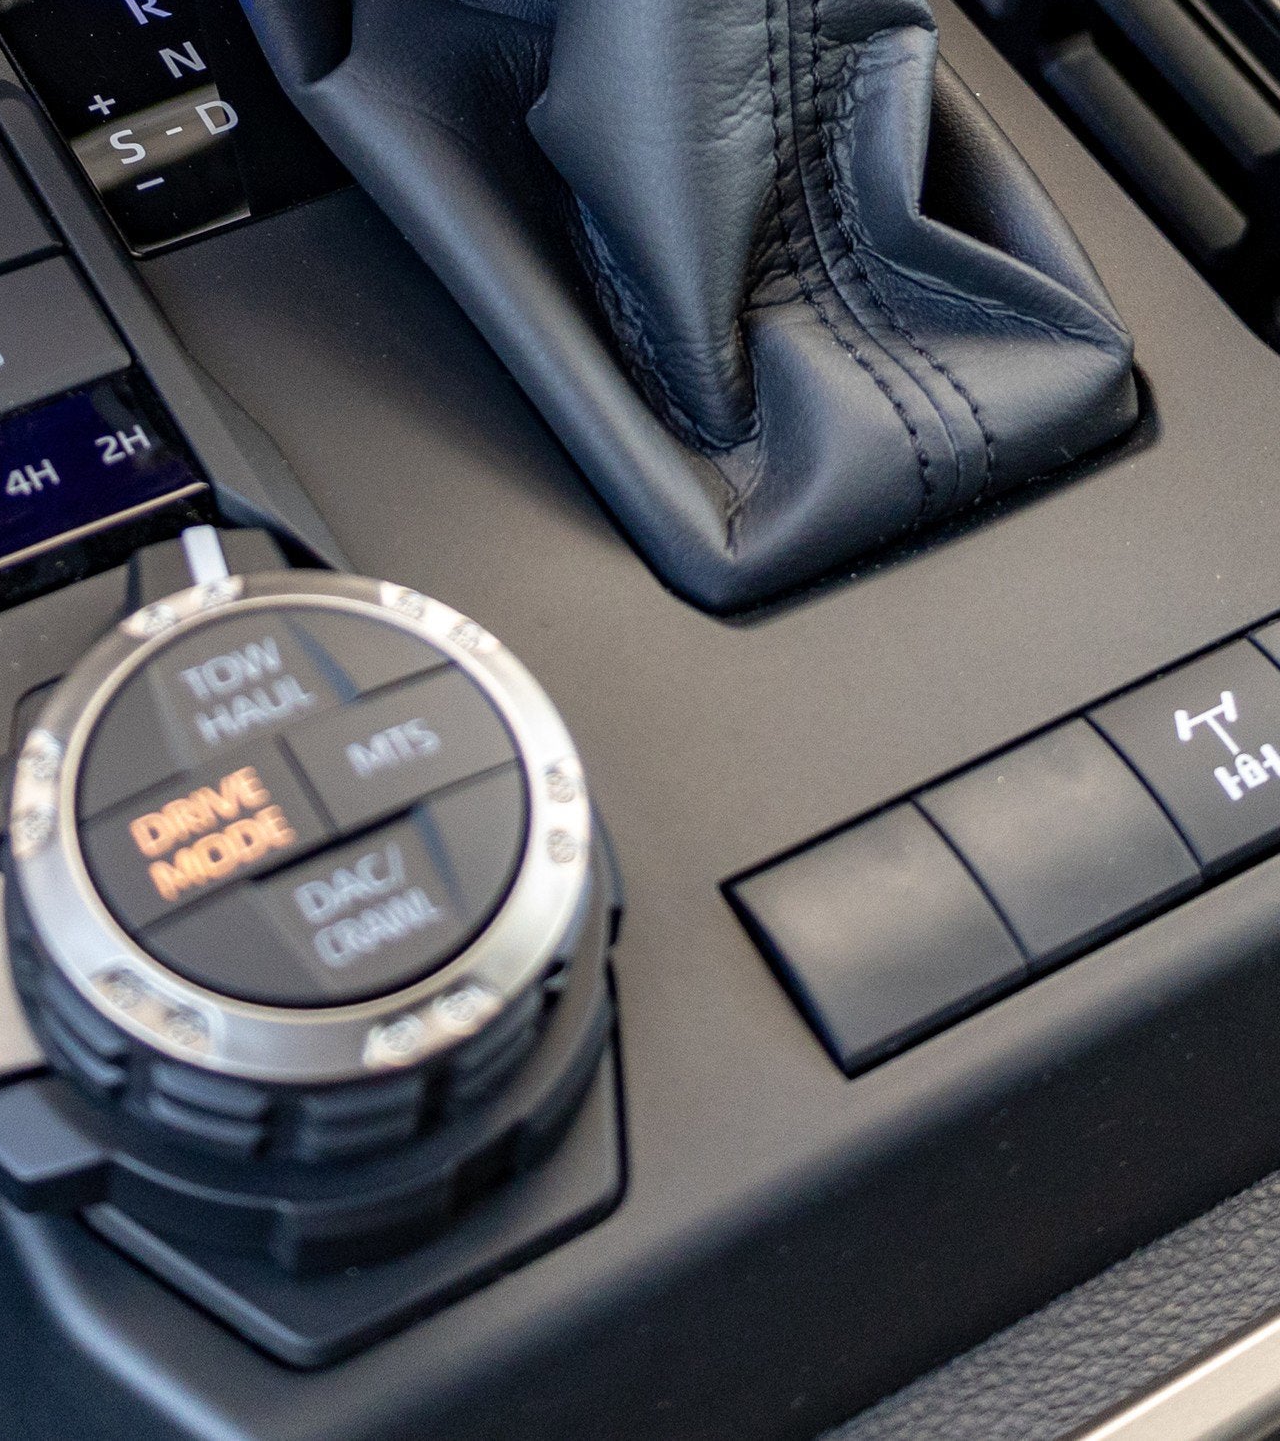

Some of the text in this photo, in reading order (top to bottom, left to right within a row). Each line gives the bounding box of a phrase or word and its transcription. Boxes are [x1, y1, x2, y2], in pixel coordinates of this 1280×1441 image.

[158, 41, 207, 79] N
[5, 459, 61, 496] 4H
[94, 424, 151, 465] 2H
[179, 637, 281, 700] TOW
[195, 675, 316, 746] HAUL
[346, 719, 441, 776] MTS
[130, 766, 270, 857] DRIVE
[148, 805, 297, 902] MODE
